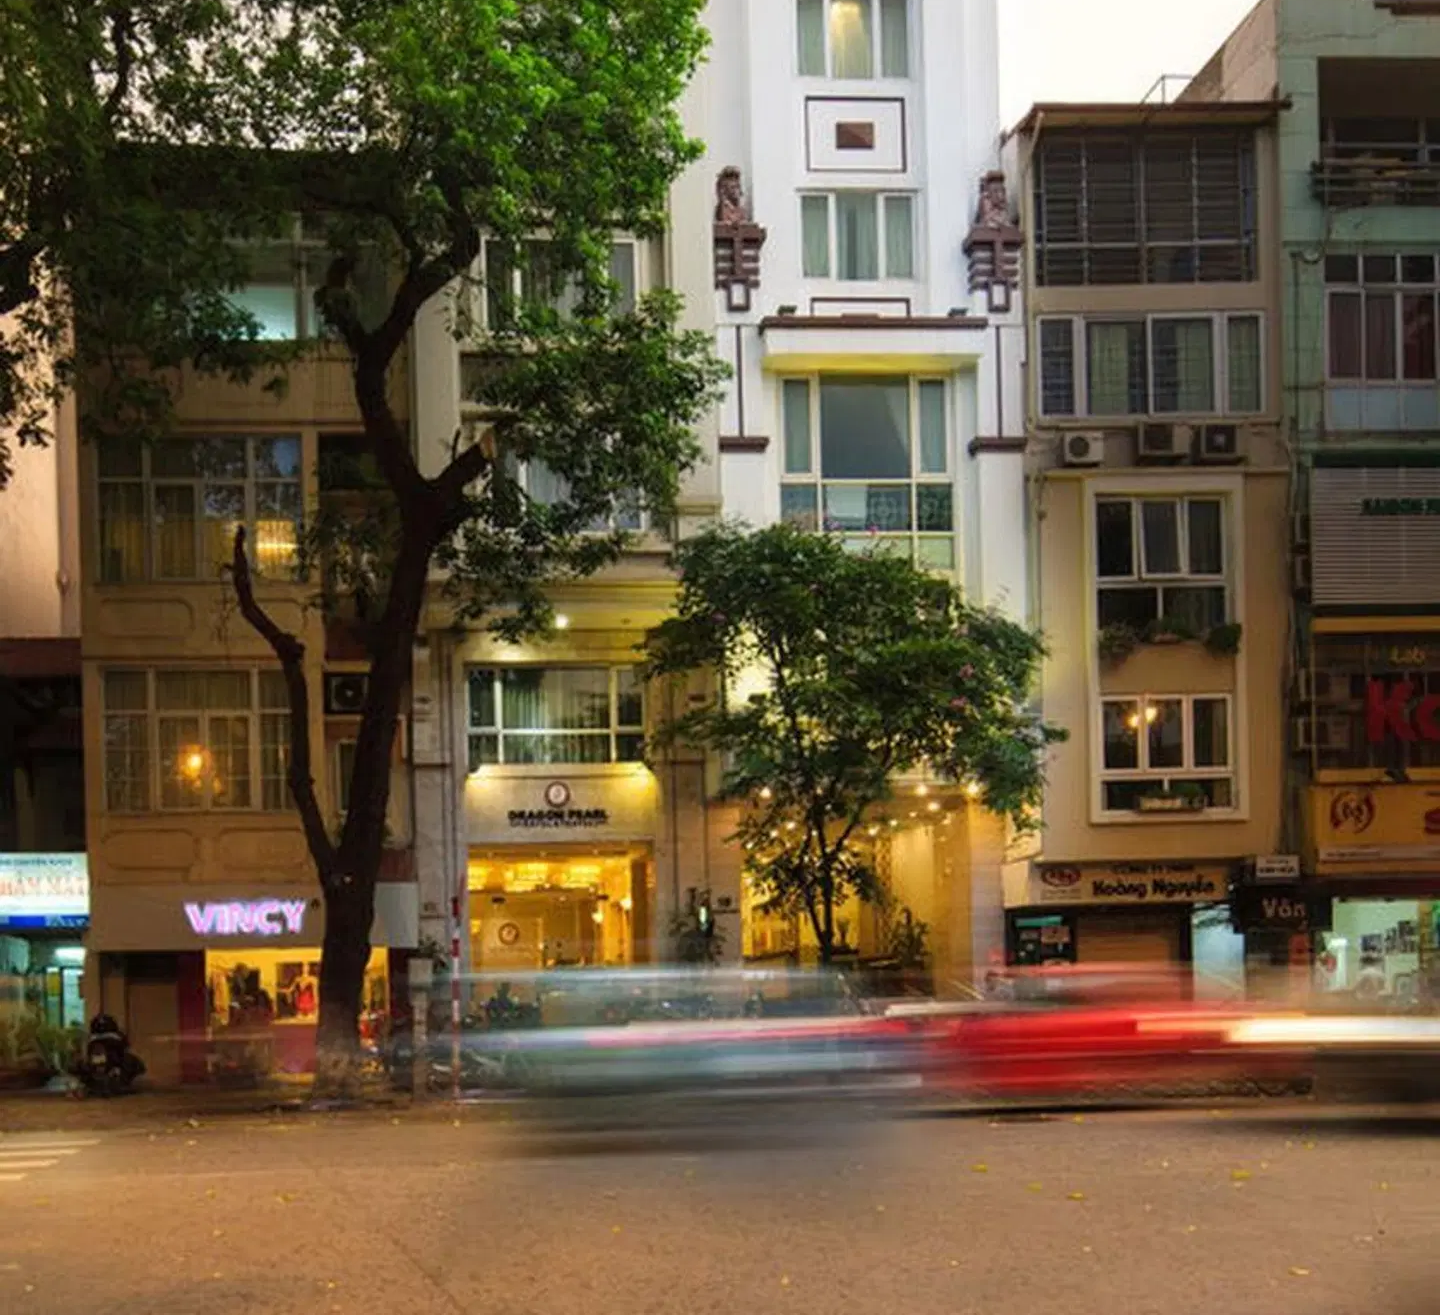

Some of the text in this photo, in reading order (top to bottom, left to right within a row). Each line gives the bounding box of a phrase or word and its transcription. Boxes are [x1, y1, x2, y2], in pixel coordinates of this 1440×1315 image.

[508, 809, 607, 820] DRAGON PEARL
[184, 899, 306, 935] VINCY
